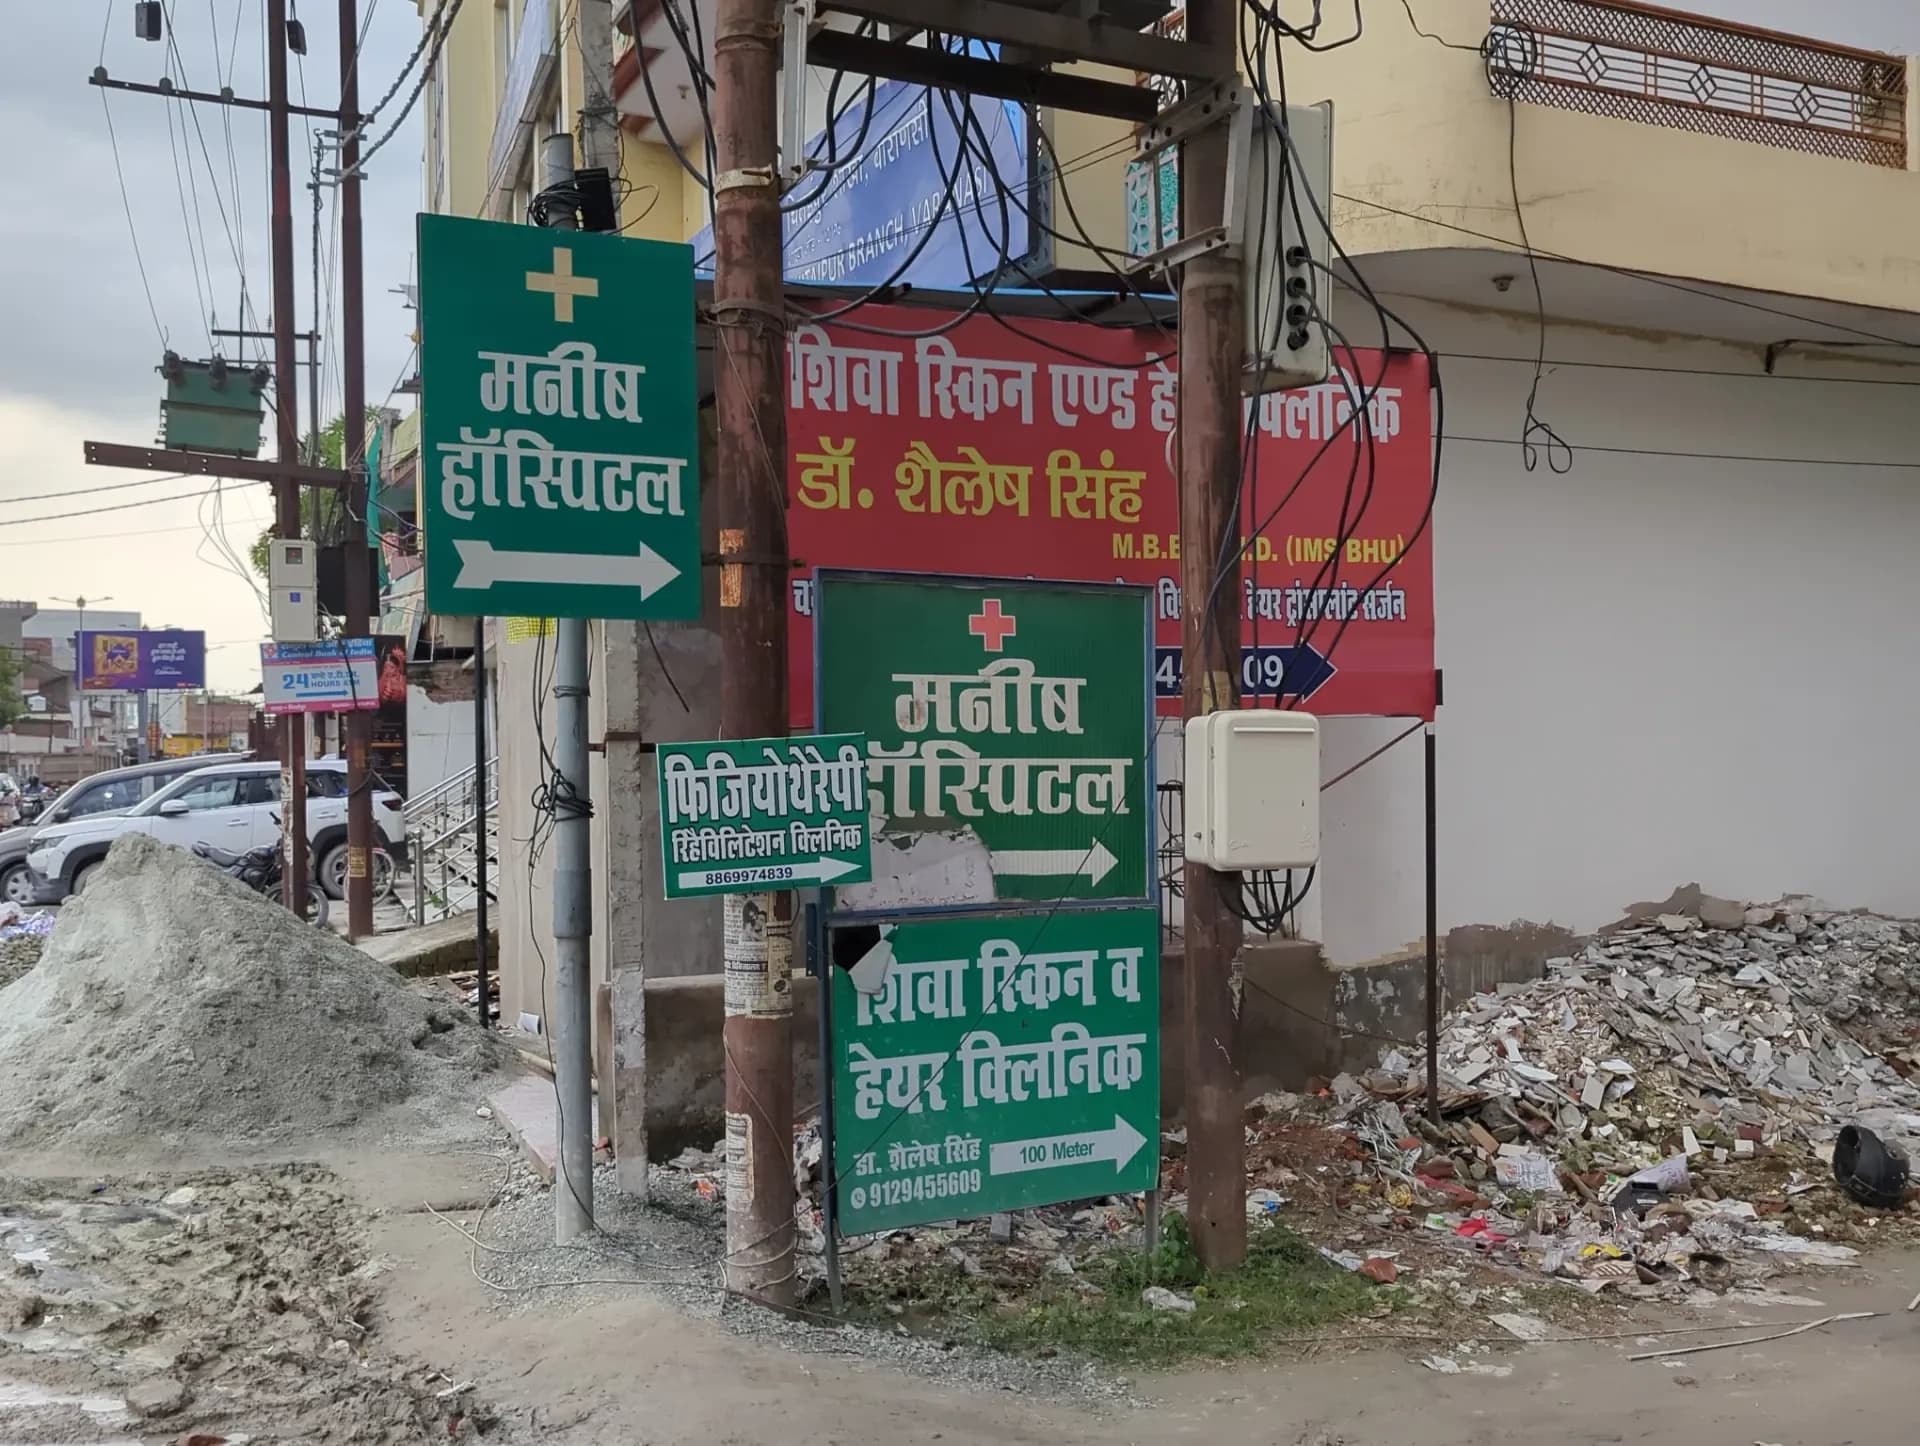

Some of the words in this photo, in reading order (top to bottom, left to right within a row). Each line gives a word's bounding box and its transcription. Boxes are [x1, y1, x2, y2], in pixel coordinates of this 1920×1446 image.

[873, 98, 929, 171] वाराणसी
[848, 212, 909, 272] BRANCH,
[478, 341, 646, 424] मनीष
[787, 325, 903, 416] शिवा
[915, 335, 1037, 425] स्किन
[1048, 364, 1139, 431] एण्ड
[437, 427, 688, 521] हॉस्पिटल
[796, 436, 874, 510] डॉ.
[895, 440, 1033, 517] शैलेष
[1045, 449, 1146, 523] सिंह
[1286, 535, 1337, 568] (IMS
[1345, 534, 1406, 565] BHU)
[1362, 580, 1407, 621] सर्जन
[282, 673, 310, 690] 24
[891, 658, 1087, 735] मनीष
[664, 745, 865, 824] फिजियोथेरेपी
[790, 818, 862, 855] क्लिनिक
[705, 866, 793, 885] 8869974839
[977, 938, 1099, 1015] स्किन
[1106, 947, 1144, 1002] व
[849, 1042, 950, 1120] हेयर
[957, 1022, 1147, 1108] क्लिनिक
[888, 1138, 940, 1171] शैलेष
[944, 1132, 983, 1165] सिंह
[1019, 1145, 1047, 1166] 100
[1052, 1140, 1096, 1162] Meter
[869, 1168, 982, 1208] 9129455609
